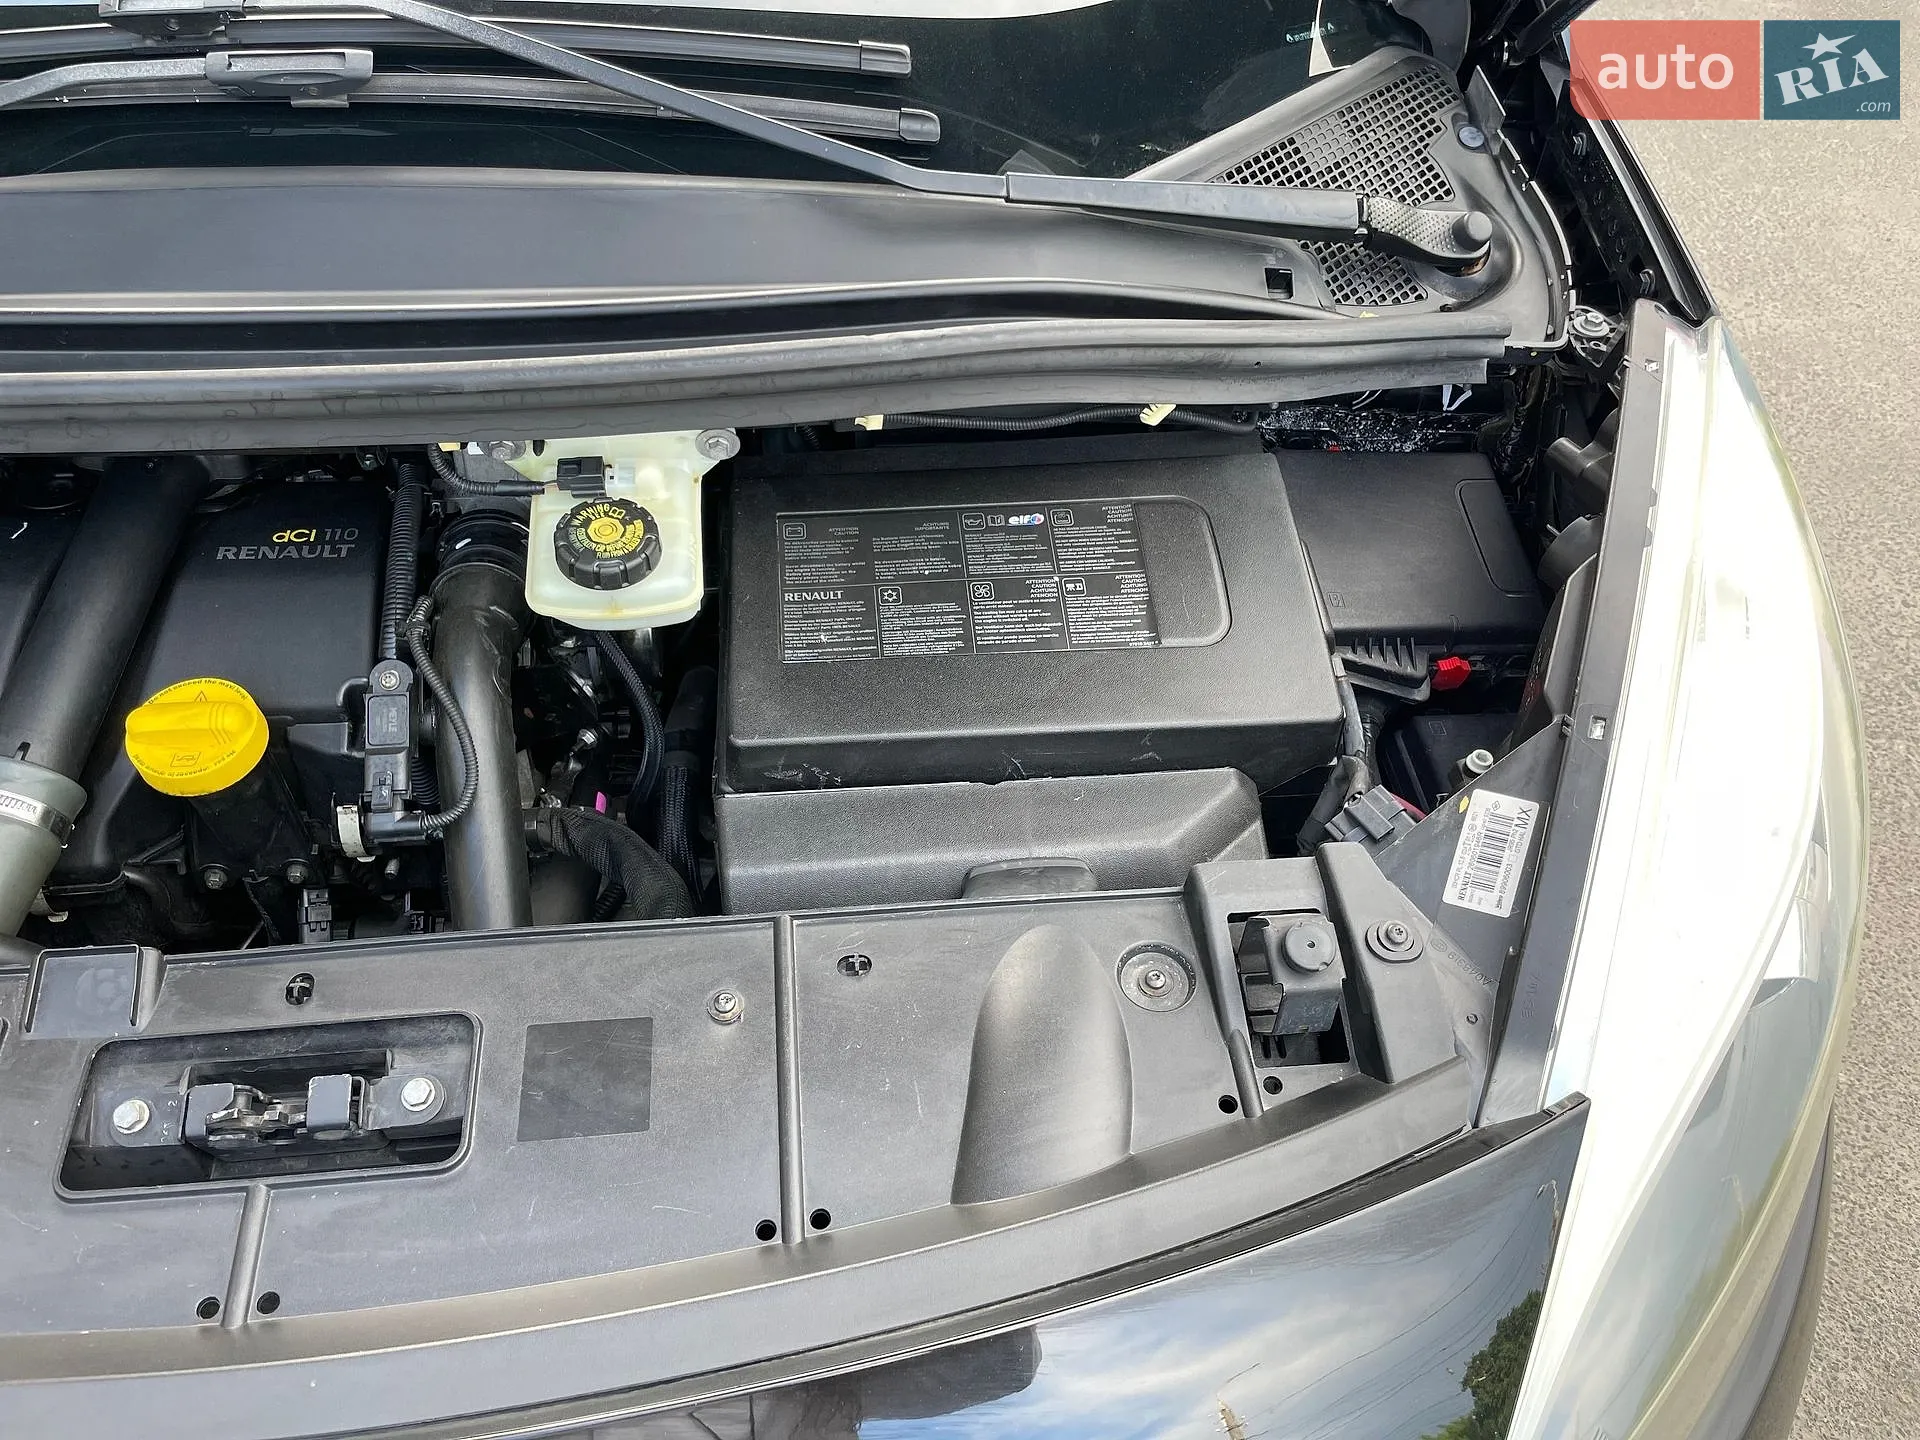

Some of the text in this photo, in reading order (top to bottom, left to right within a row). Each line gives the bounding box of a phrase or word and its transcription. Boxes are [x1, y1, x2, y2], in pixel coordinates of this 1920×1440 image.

[571, 504, 610, 526] WARNING
[1009, 515, 1034, 524] elf
[324, 528, 359, 541] 110
[216, 544, 356, 560] RENAULT
[784, 591, 844, 601] RENAULT
[1514, 807, 1532, 830] MX
[1458, 871, 1472, 901] RENAULT
